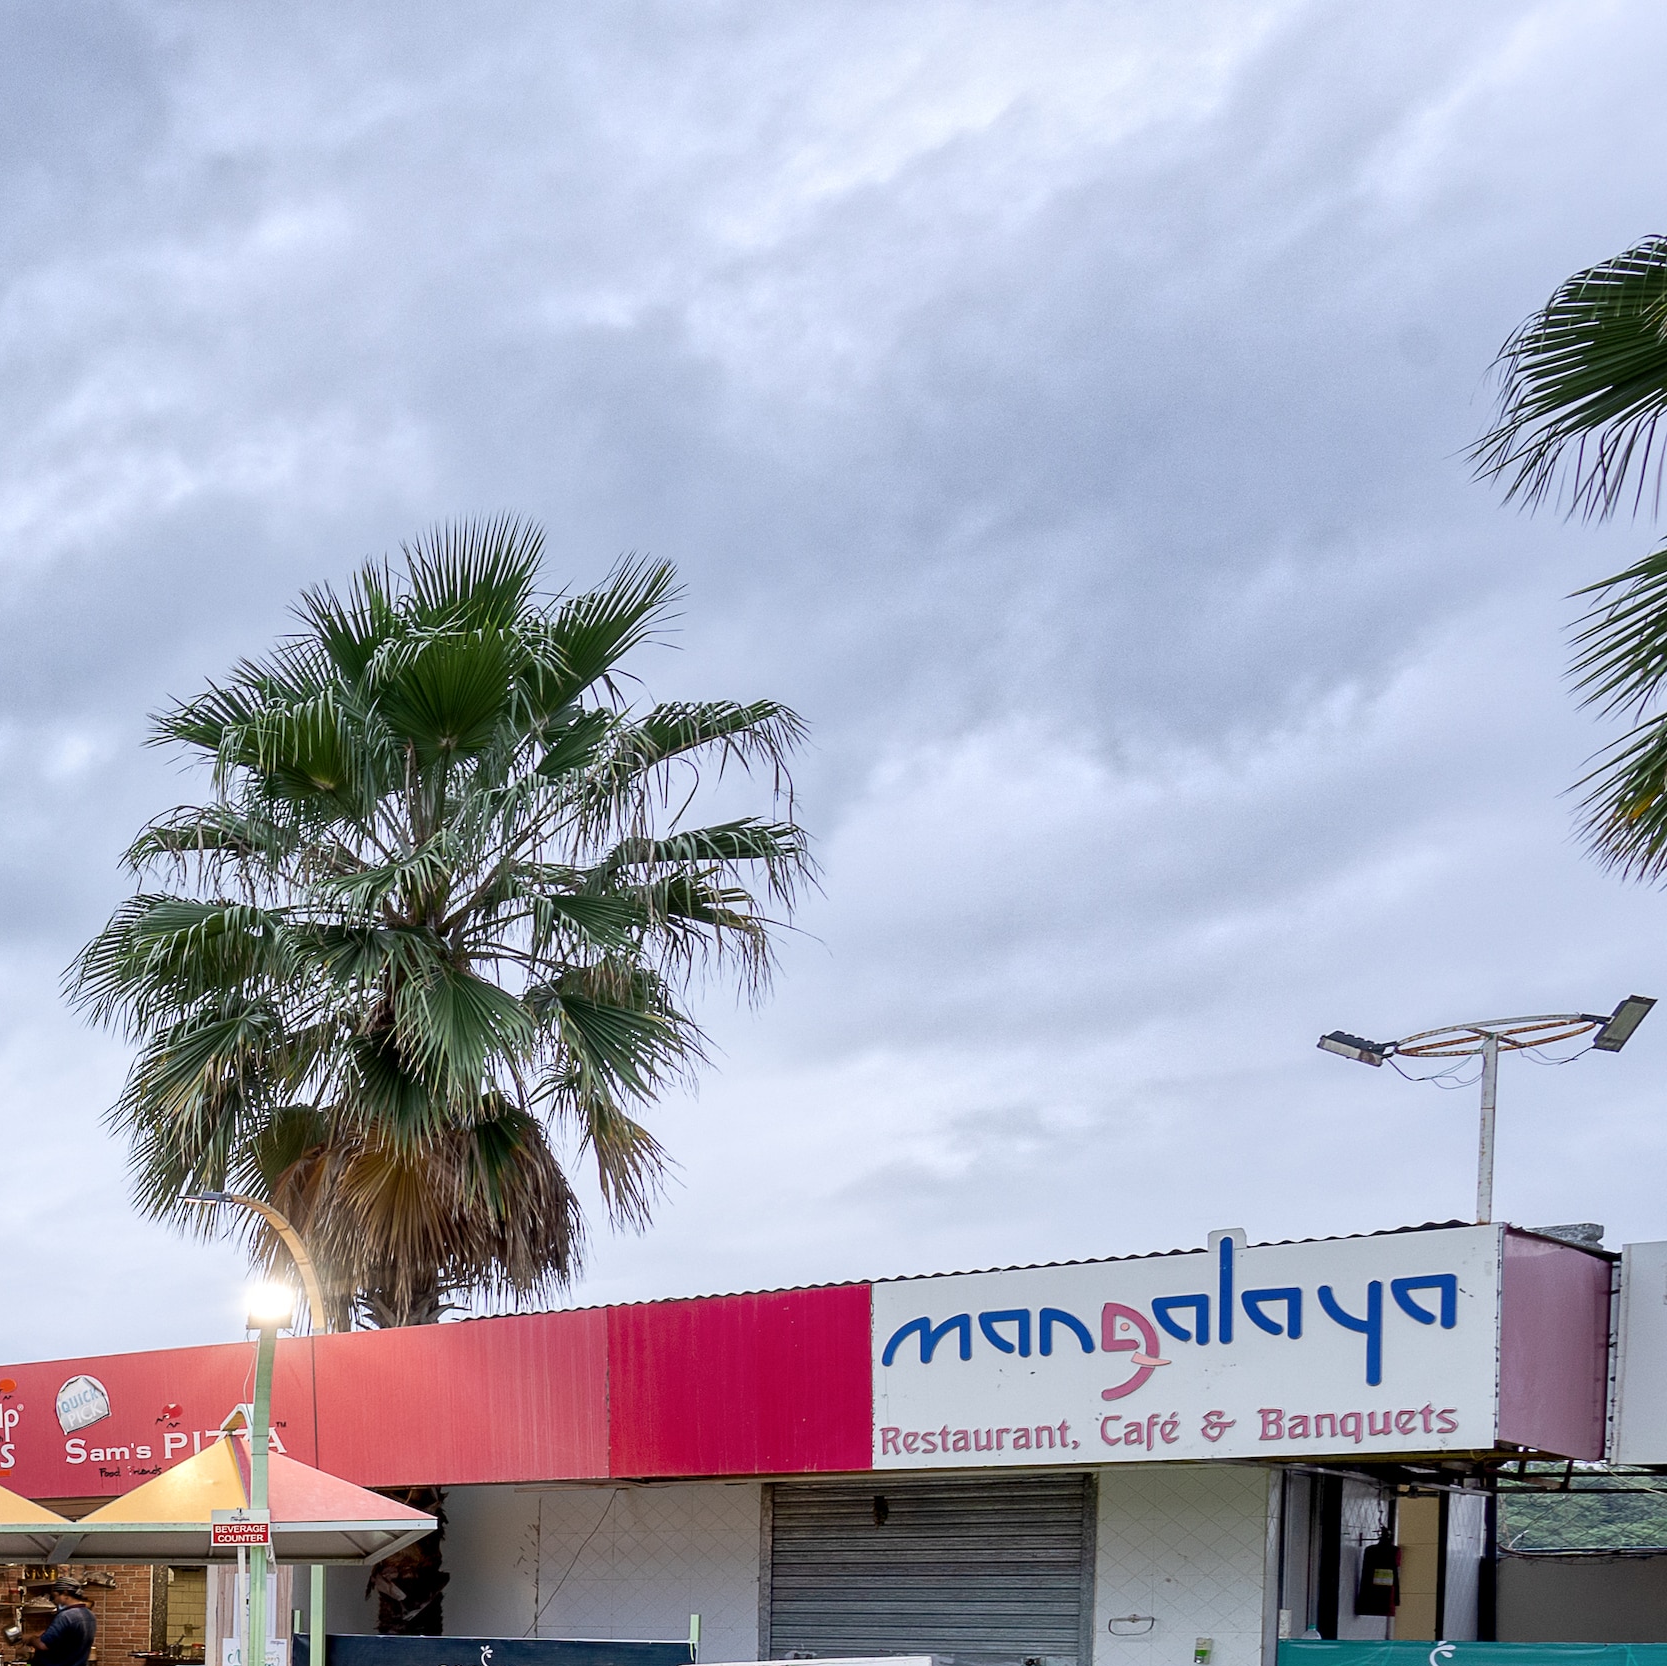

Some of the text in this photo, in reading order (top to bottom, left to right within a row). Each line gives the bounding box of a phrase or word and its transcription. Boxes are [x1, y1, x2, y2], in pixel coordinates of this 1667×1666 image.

[881, 1235, 1457, 1400] mangalaya
[61, 1387, 99, 1414] QUICK
[67, 1402, 103, 1427] PICK
[880, 1402, 1460, 1456] Restaurant, Café & Banquets
[65, 1438, 152, 1464] Sam's
[99, 1465, 163, 1477] Food riends
[215, 1525, 267, 1534] BEVERAGE
[217, 1534, 264, 1543] COUNTER
